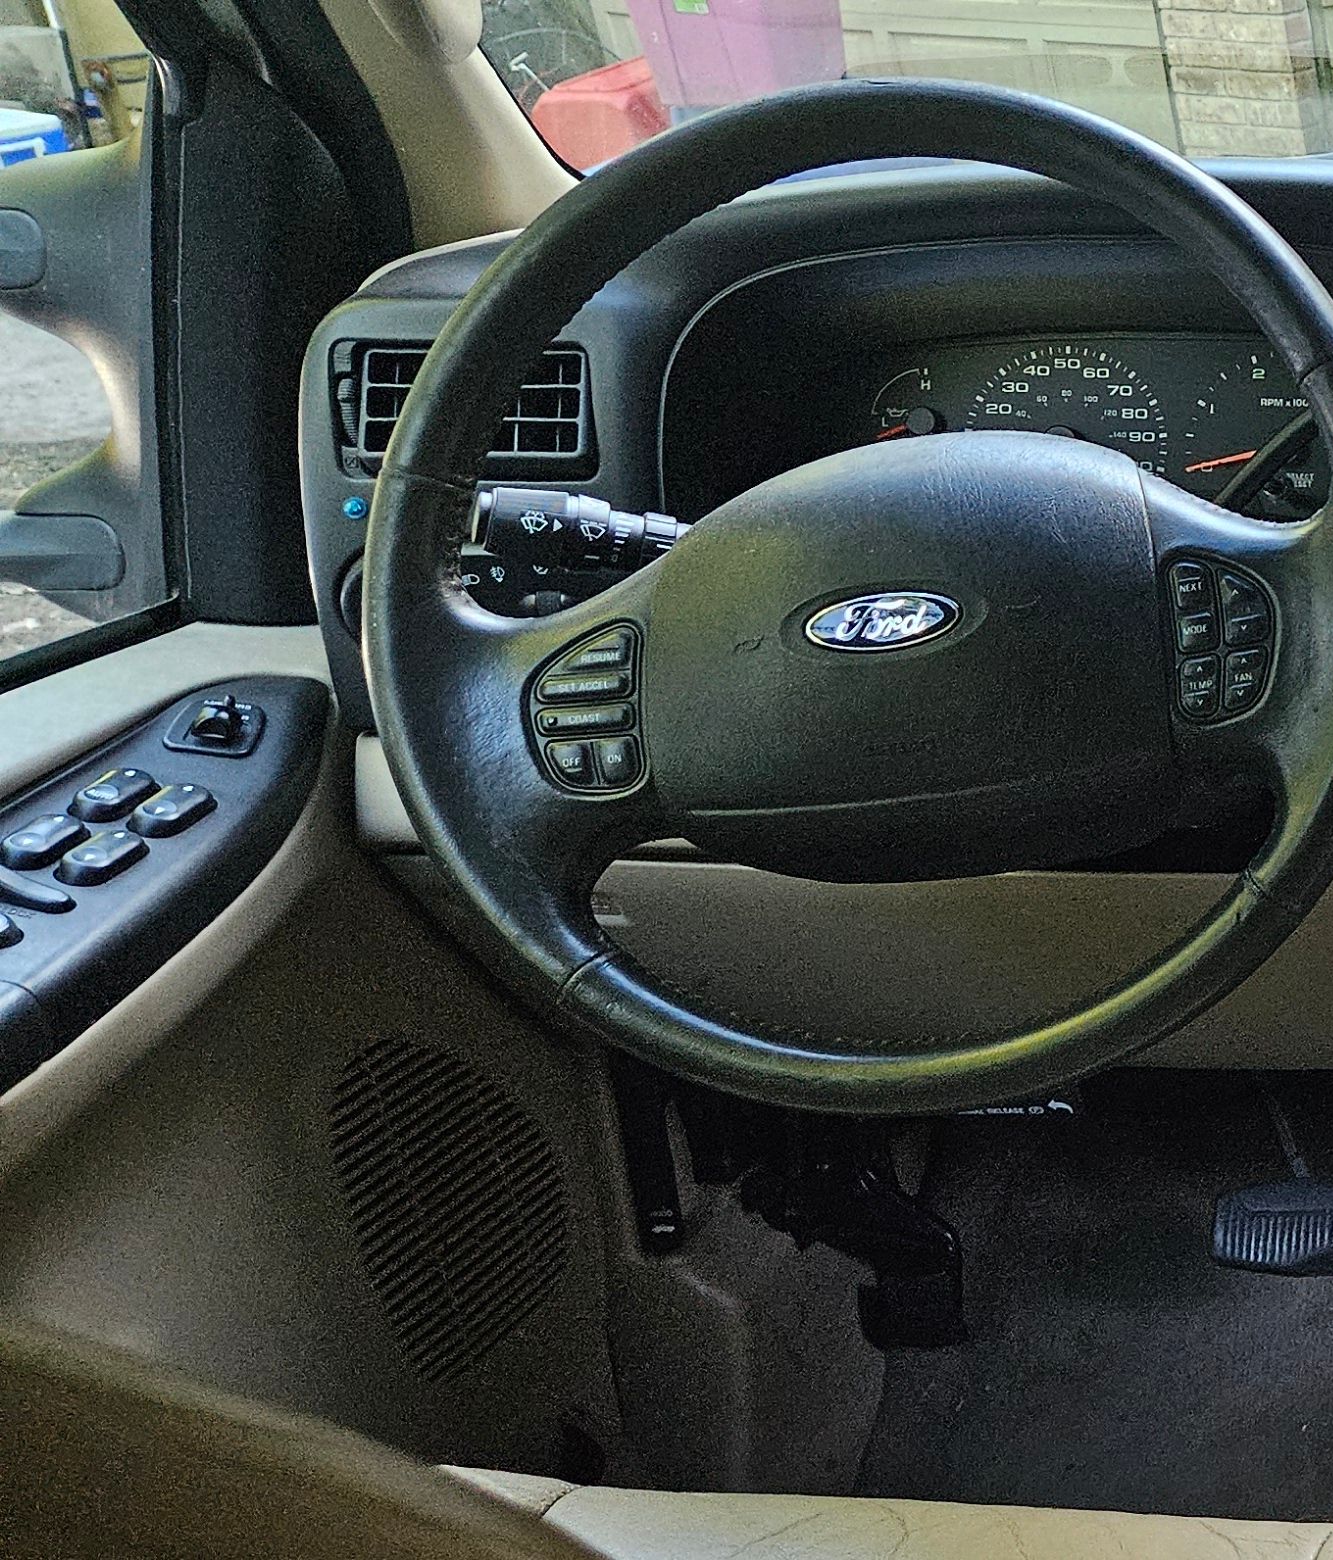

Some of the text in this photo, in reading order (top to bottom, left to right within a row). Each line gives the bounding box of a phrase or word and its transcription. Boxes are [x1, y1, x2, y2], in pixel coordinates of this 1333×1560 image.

[1054, 358, 1081, 369] 50
[1023, 365, 1050, 376] 40
[1083, 368, 1110, 379] 60
[1252, 368, 1265, 379] 2
[921, 379, 931, 390] H
[1001, 382, 1029, 393] 30
[1107, 384, 1133, 396] 70
[1260, 398, 1283, 407] RPM
[985, 403, 1012, 414] 20
[1121, 408, 1148, 419] 80
[882, 416, 889, 427] L
[1128, 431, 1156, 443] 90
[1179, 582, 1202, 592] NEXT
[835, 599, 926, 641] Ford
[1183, 624, 1208, 635] MODE
[580, 653, 621, 664] RESUME
[1234, 673, 1253, 682] FAN
[579, 681, 609, 690] ACCEL
[1188, 680, 1213, 690] TEMP
[568, 713, 601, 725] COAST
[562, 757, 581, 768] OFF
[607, 753, 622, 764] ON
